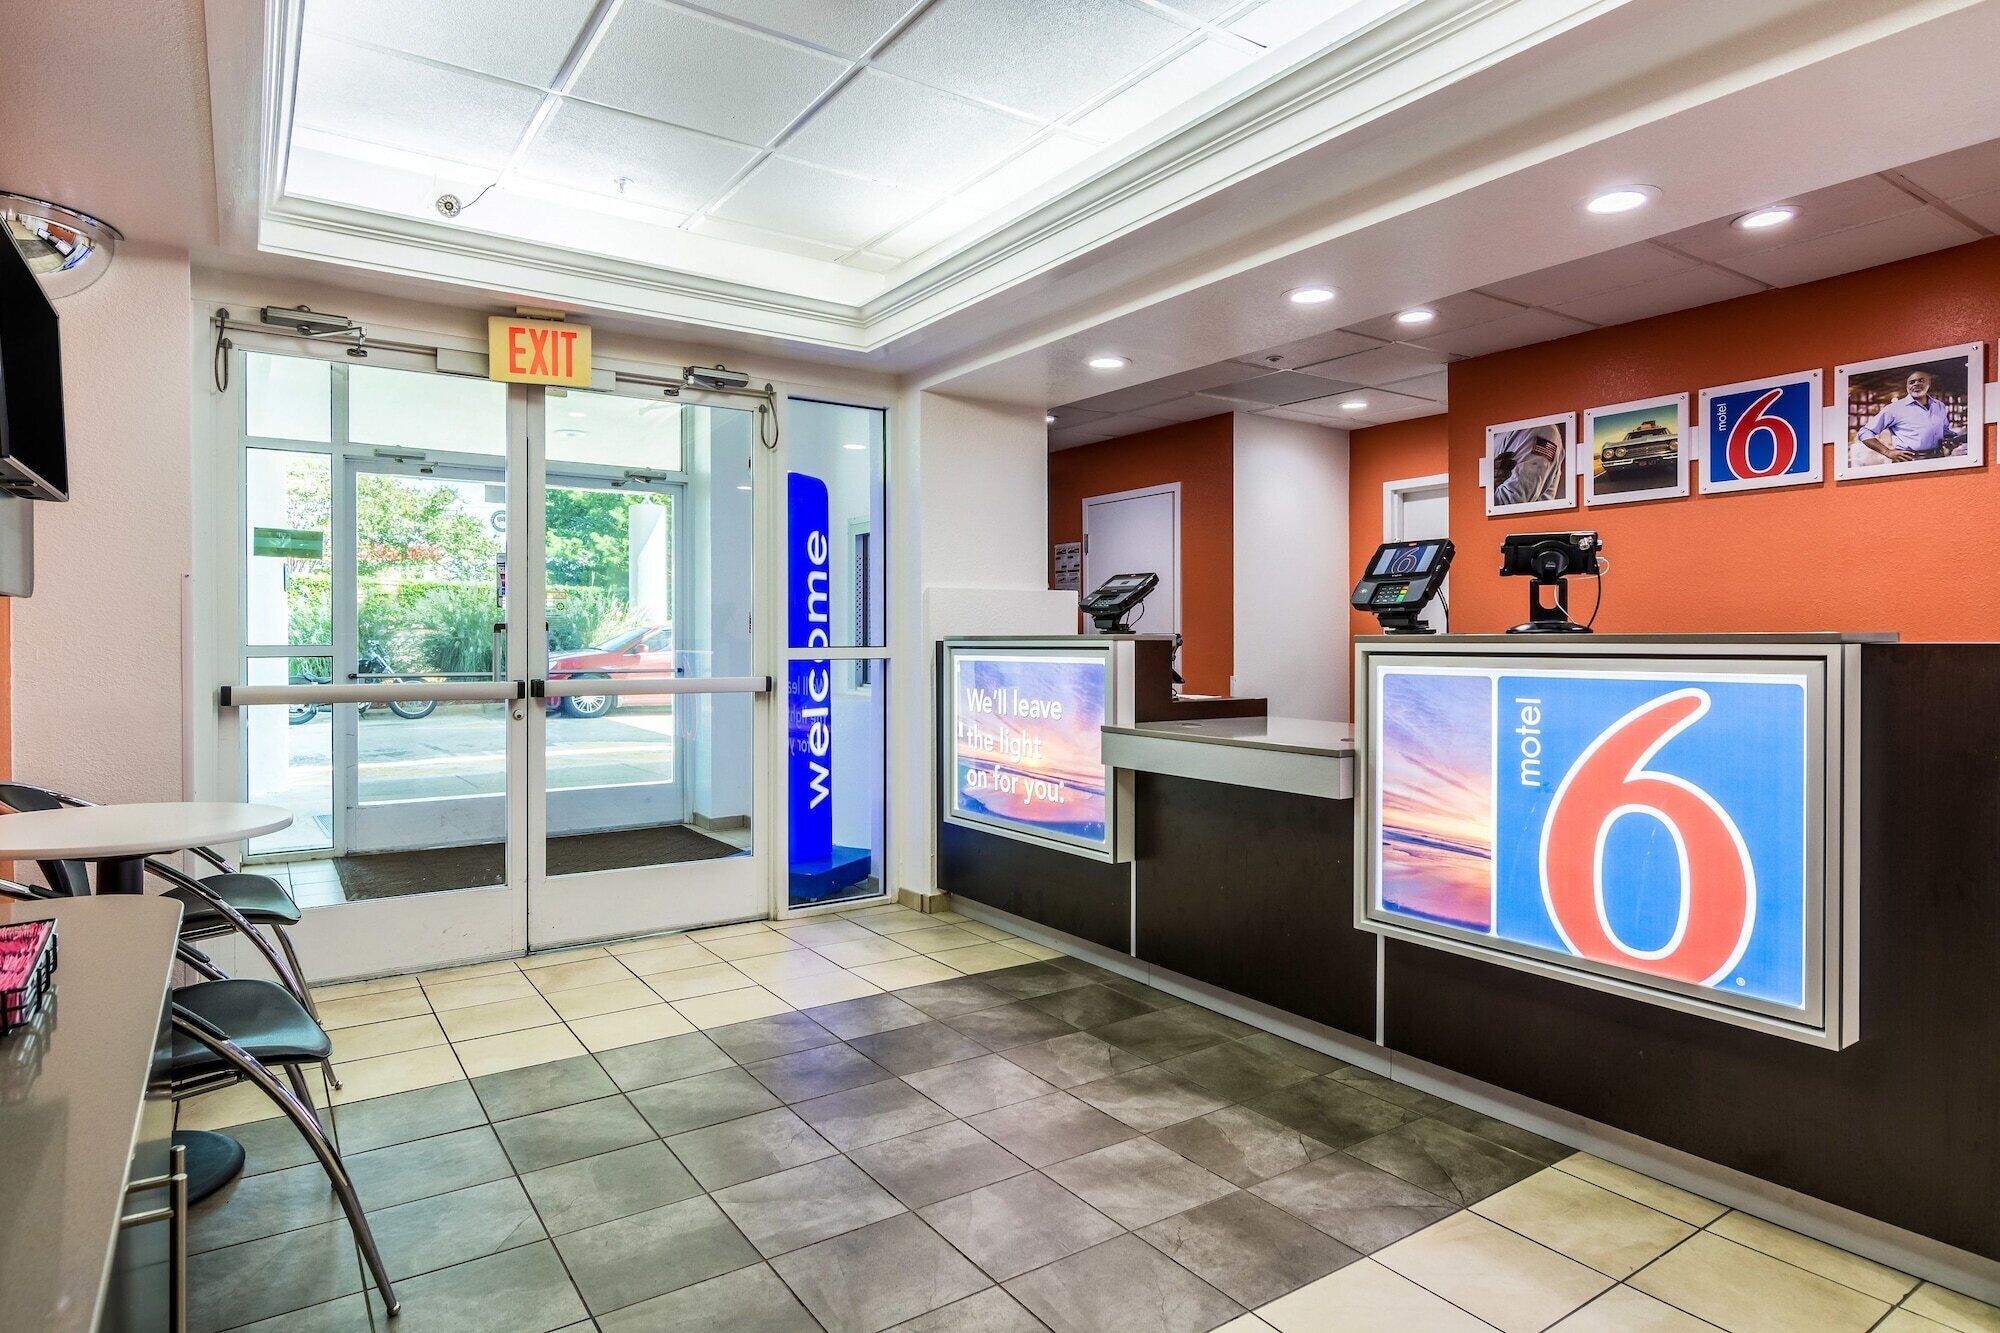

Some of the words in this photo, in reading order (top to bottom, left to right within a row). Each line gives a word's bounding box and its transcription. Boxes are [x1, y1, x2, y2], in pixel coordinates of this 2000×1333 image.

[508, 326, 578, 378] EXIT
[1716, 402, 1727, 432] motel
[1726, 388, 1797, 479] 6
[802, 530, 831, 810] welcome
[966, 687, 1007, 715] We'll
[1013, 689, 1062, 721] leave
[966, 721, 994, 752] the
[999, 727, 1042, 763] light
[966, 768, 987, 788] on
[992, 765, 1019, 794] for
[1515, 697, 1542, 787] motel
[1539, 688, 1757, 988] 6
